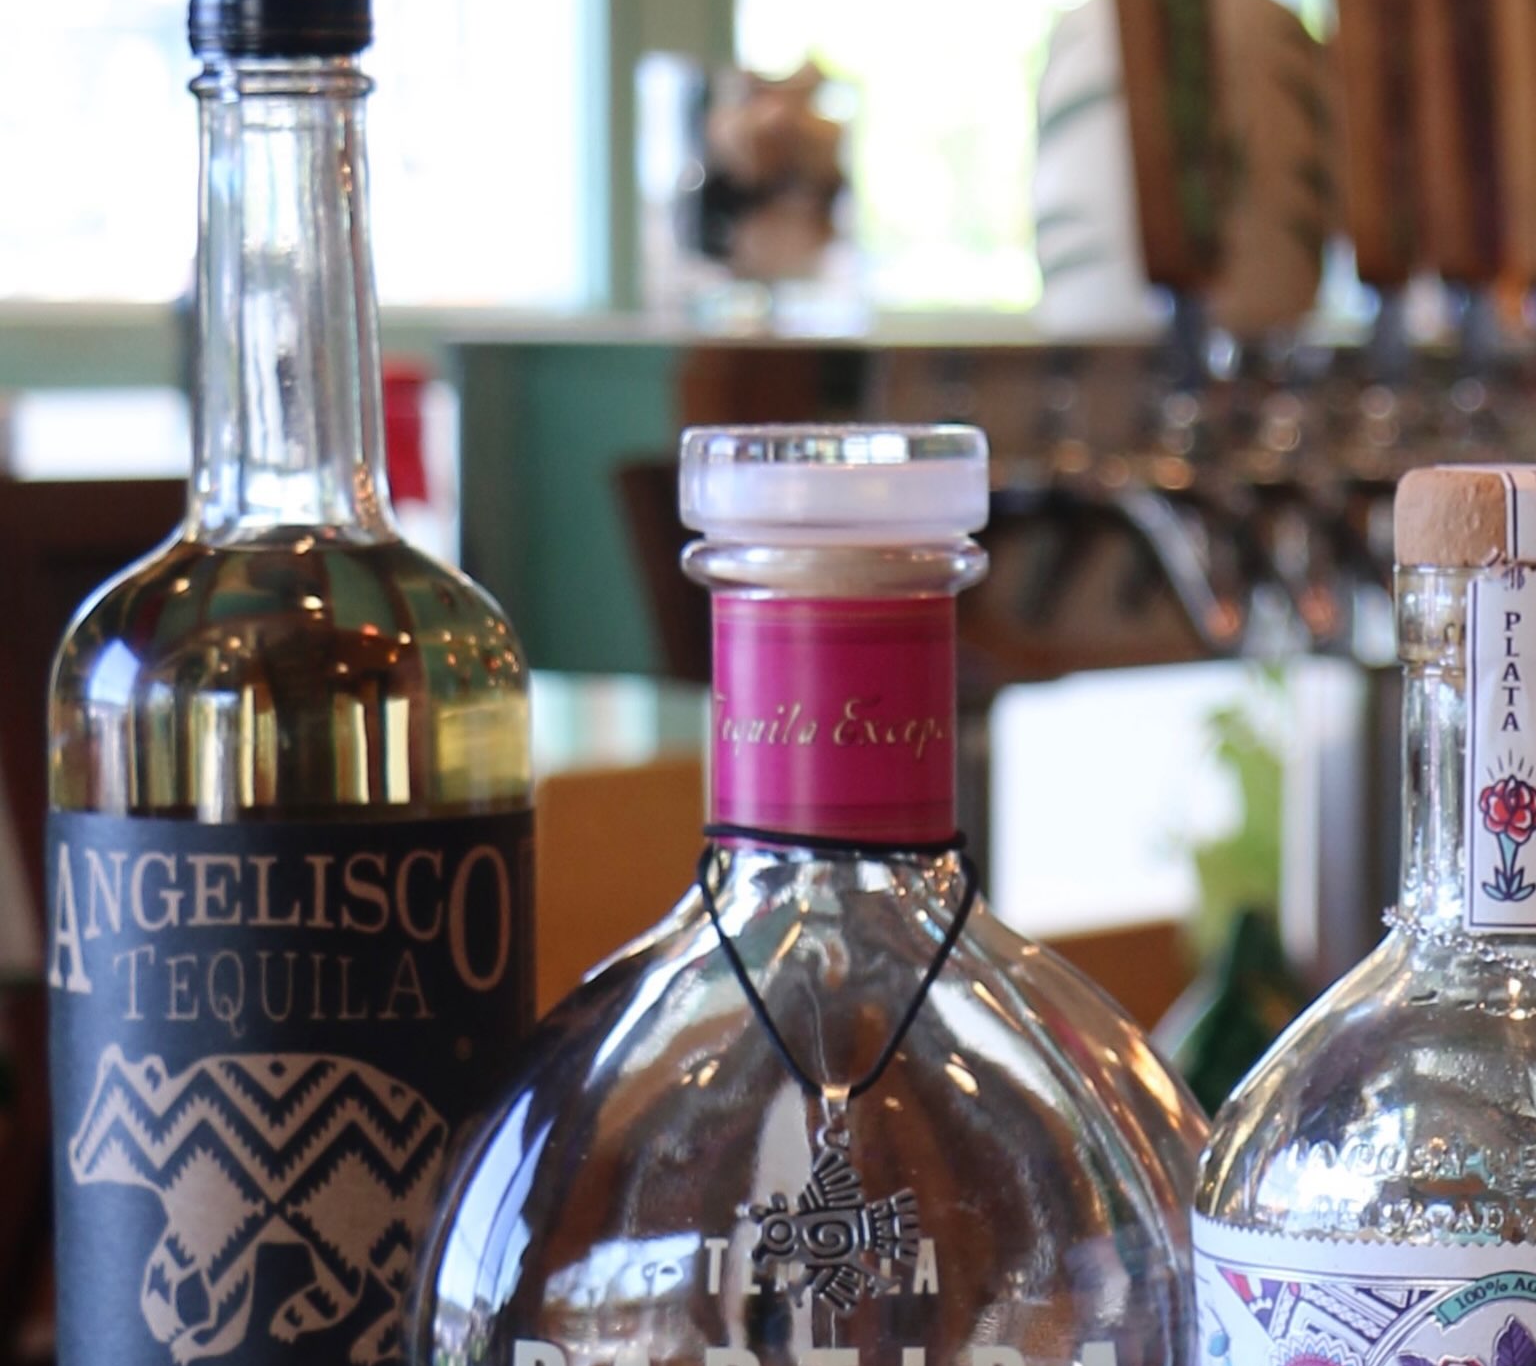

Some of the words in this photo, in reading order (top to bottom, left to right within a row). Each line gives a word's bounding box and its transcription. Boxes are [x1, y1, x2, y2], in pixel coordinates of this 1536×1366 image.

[1501, 611, 1521, 733] PLATA
[49, 841, 512, 994] ANGELISCO
[113, 943, 435, 1038] TEQUILA
[1455, 1278, 1509, 1310] 100%
